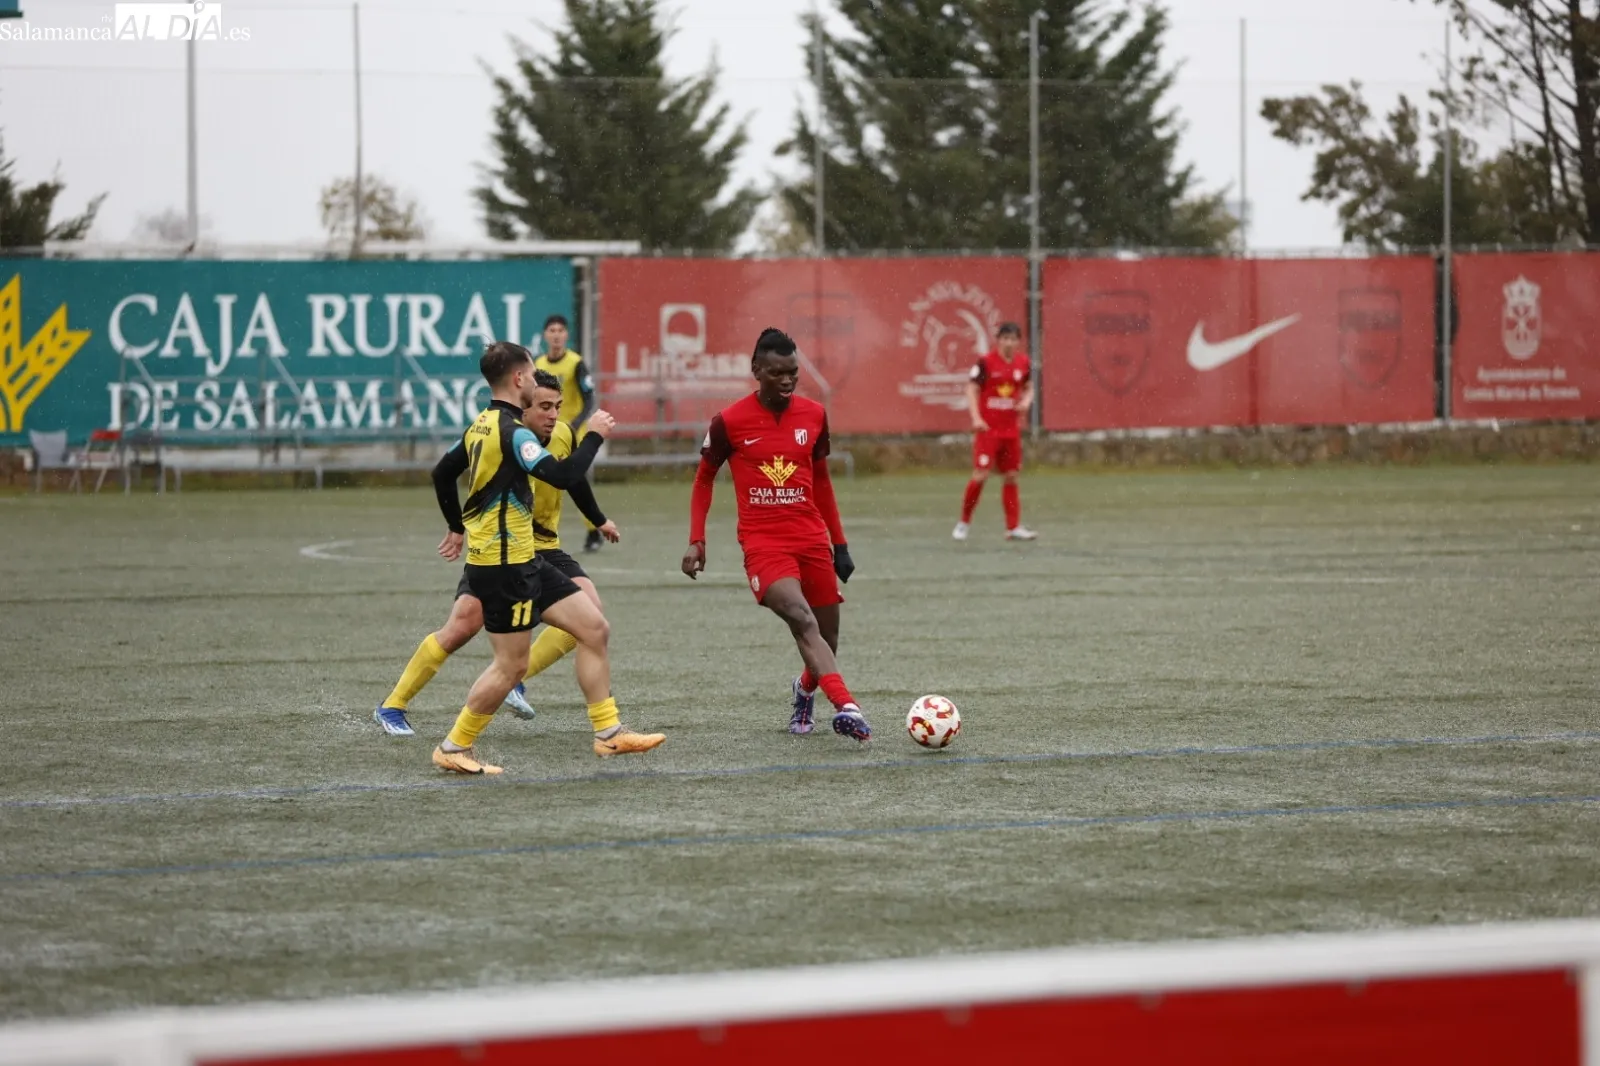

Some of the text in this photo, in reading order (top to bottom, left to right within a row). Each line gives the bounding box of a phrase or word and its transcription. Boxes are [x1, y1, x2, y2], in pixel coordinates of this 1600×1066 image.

[108, 291, 541, 377] CAJA RURAL
[108, 379, 490, 433] DE SALAMANC
[749, 487, 804, 497] CAJA RURAL
[511, 599, 534, 628] 11
